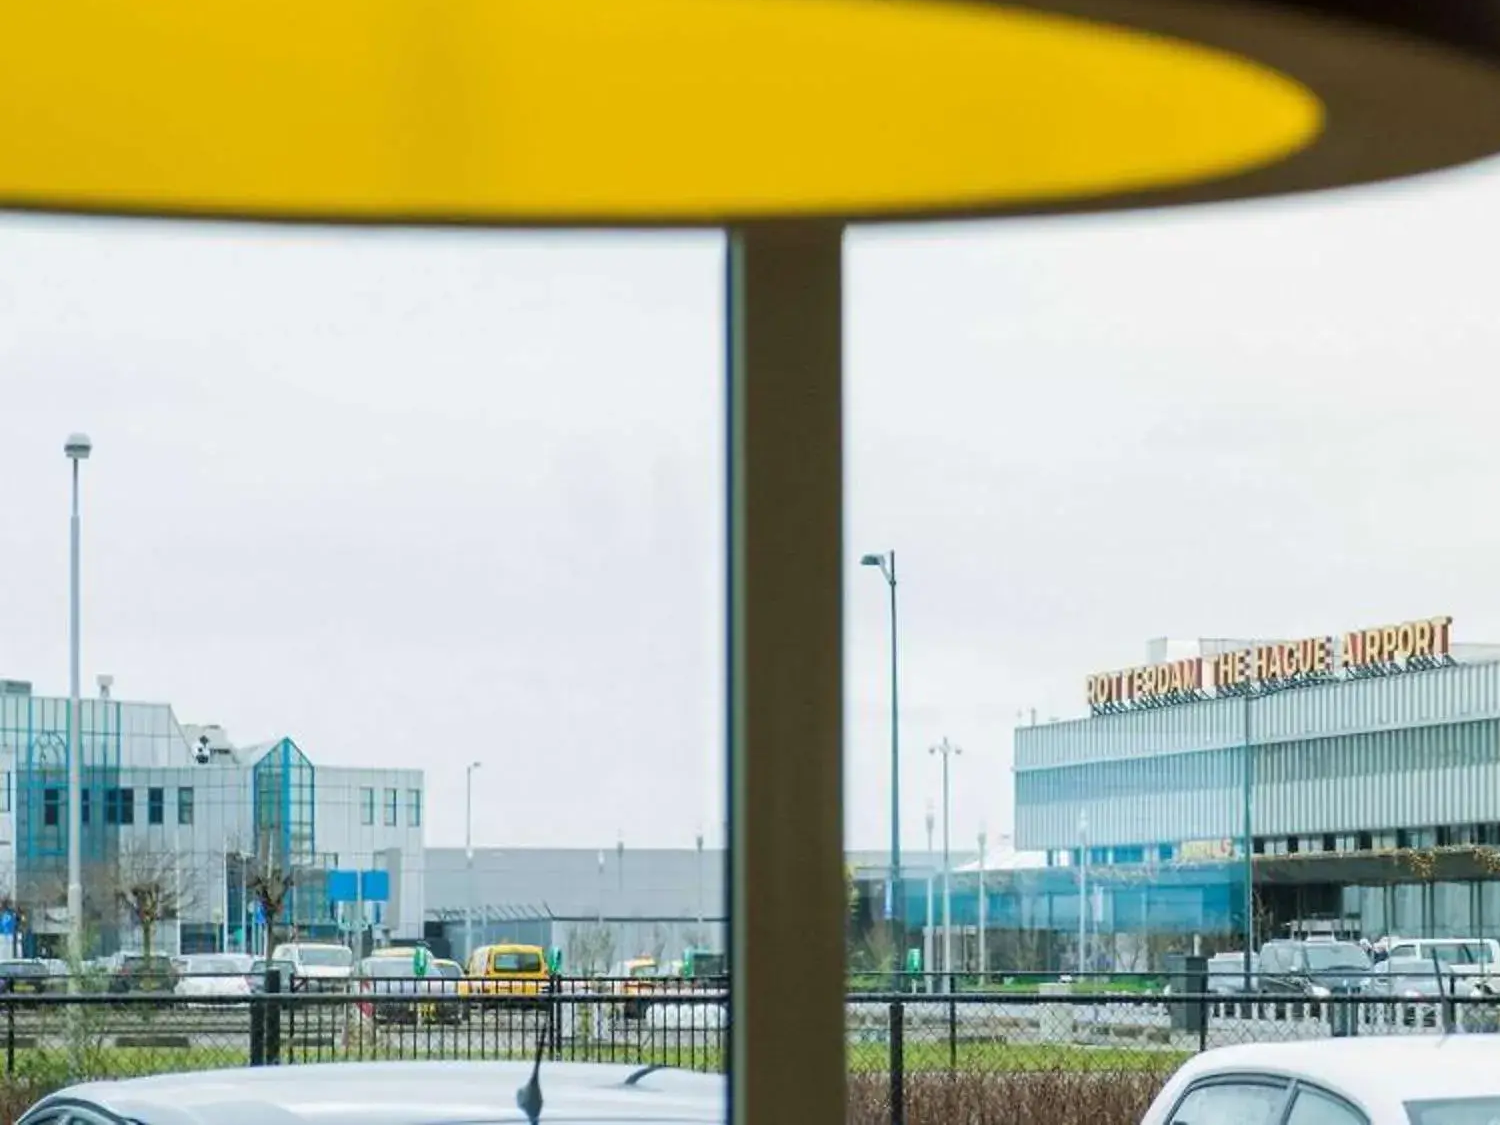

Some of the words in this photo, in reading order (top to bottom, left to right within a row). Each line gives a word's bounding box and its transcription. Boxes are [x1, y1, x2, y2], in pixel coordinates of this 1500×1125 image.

[1086, 658, 1202, 704] ROTTERDAM
[1203, 650, 1250, 687] THE
[1253, 637, 1332, 679] HAGUE
[1341, 616, 1452, 668] AIRPORT
